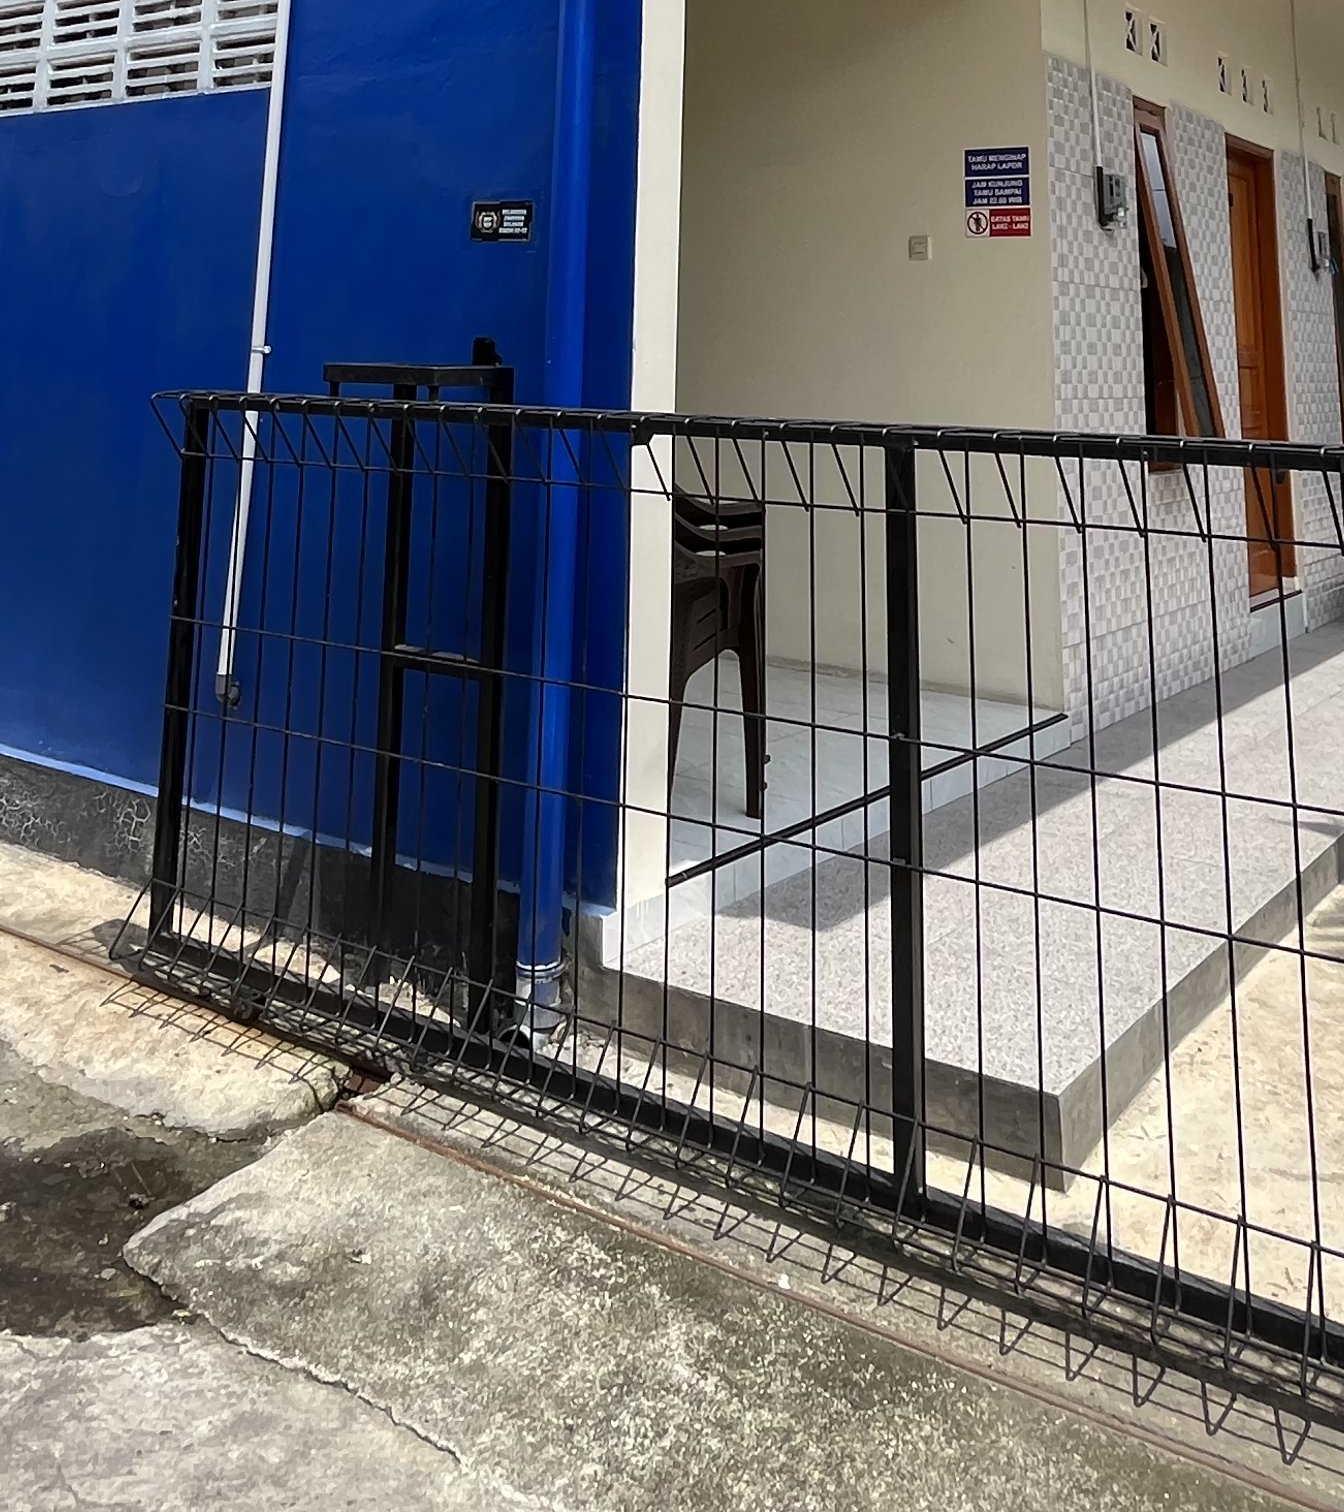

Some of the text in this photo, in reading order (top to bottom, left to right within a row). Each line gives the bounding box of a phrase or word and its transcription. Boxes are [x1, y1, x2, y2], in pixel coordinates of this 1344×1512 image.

[989, 153, 1027, 162] MENGINAP
[971, 162, 1023, 171] HARAP LAPOR
[988, 179, 1023, 187] KUNJUNG
[995, 188, 1022, 196] SAMPAI
[973, 197, 988, 205] JAM
